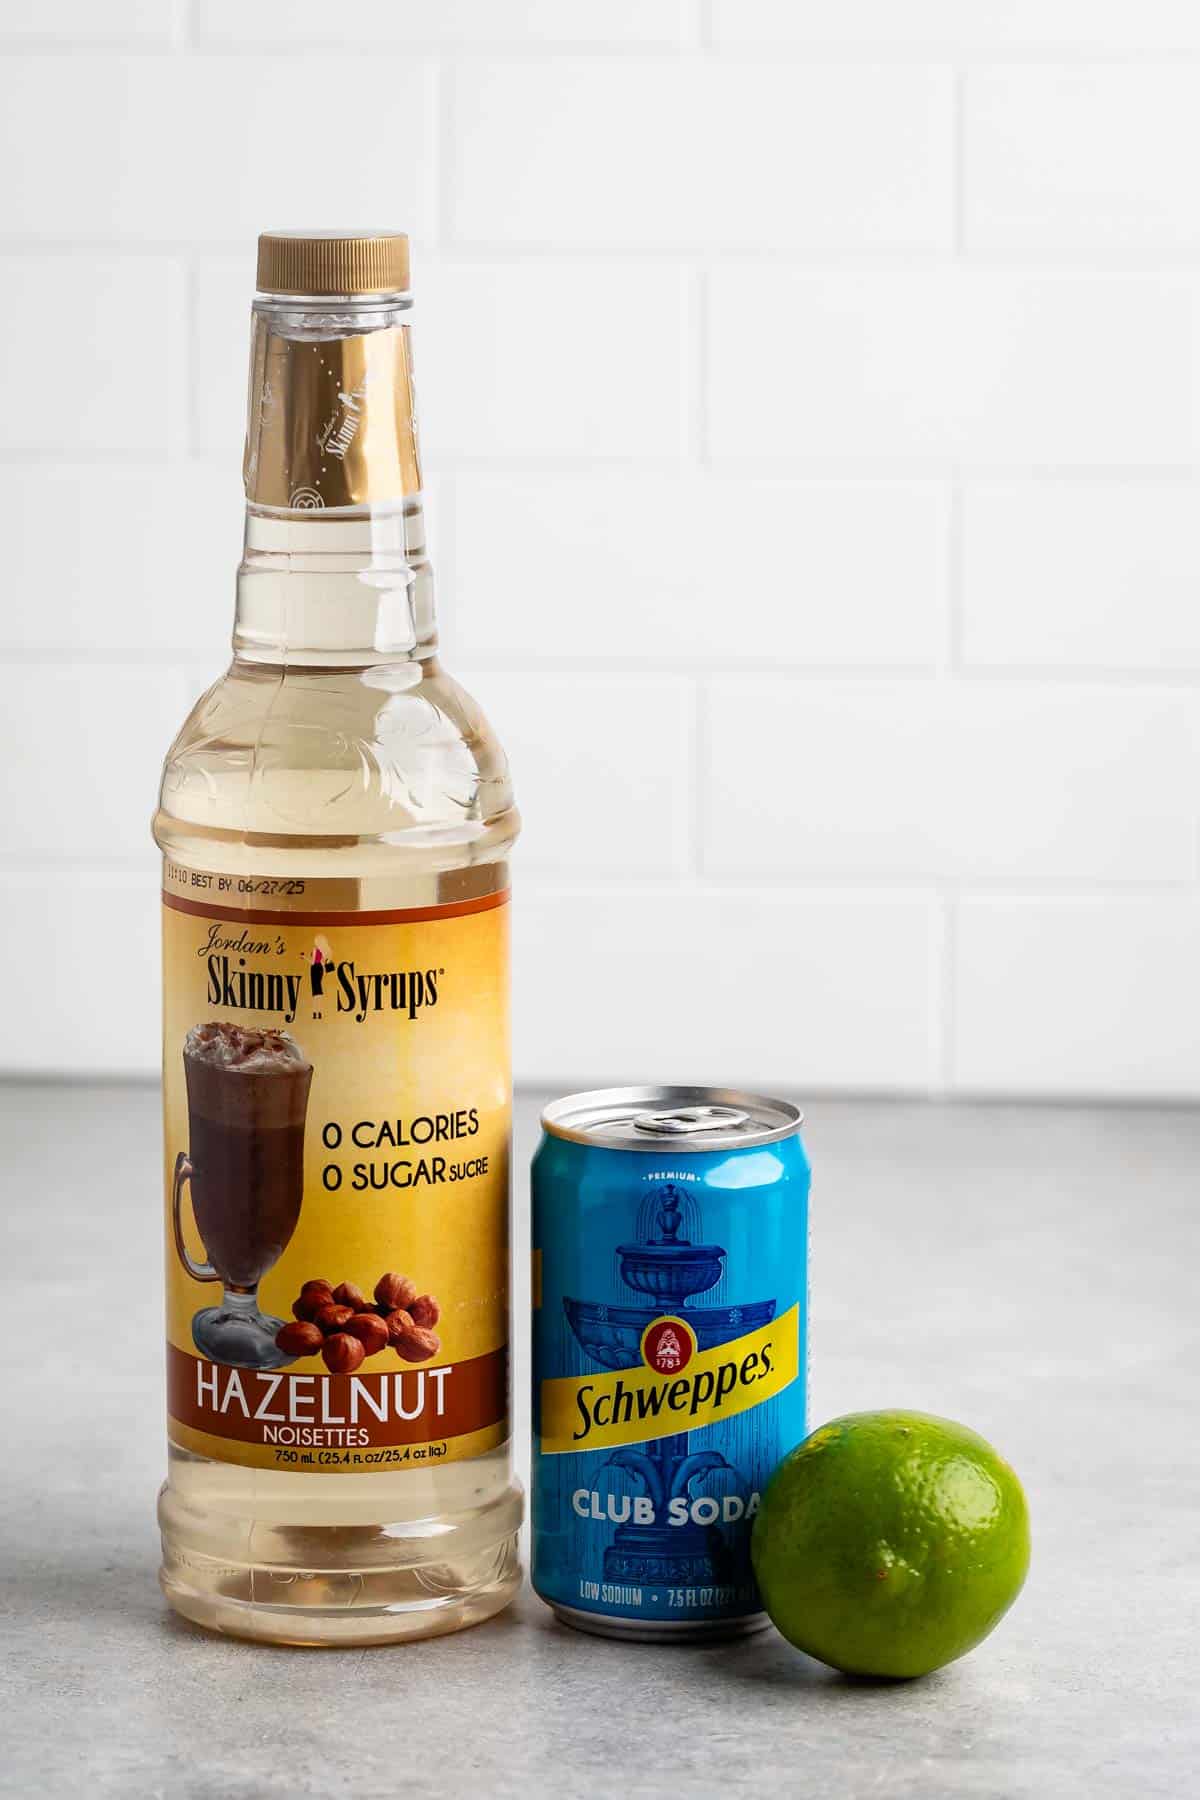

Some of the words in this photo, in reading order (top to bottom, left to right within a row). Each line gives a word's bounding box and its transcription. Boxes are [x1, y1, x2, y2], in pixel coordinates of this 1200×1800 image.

[191, 872, 212, 889] BEST
[218, 877, 232, 891] BY
[238, 880, 305, 895] 06/27/25
[198, 924, 287, 956] Jordan's
[207, 954, 302, 1023] Skinny
[336, 961, 437, 1022] Syrups
[352, 1108, 479, 1148] CALORIES
[351, 1157, 446, 1190] SUGAR
[449, 1156, 488, 1181] SUCRE
[647, 1172, 696, 1182] PREMIUM
[656, 1357, 681, 1369] 1783
[196, 1360, 452, 1425] HAZELNUT
[263, 1424, 369, 1447] NOISETTES
[275, 1449, 298, 1463] 750
[318, 1451, 350, 1465] (25.4
[572, 1489, 656, 1526] CLUB
[579, 1580, 600, 1601] LOW
[601, 1583, 642, 1607] SODIUM
[667, 1589, 684, 1608] 7.5
[686, 1590, 699, 1608] FL
